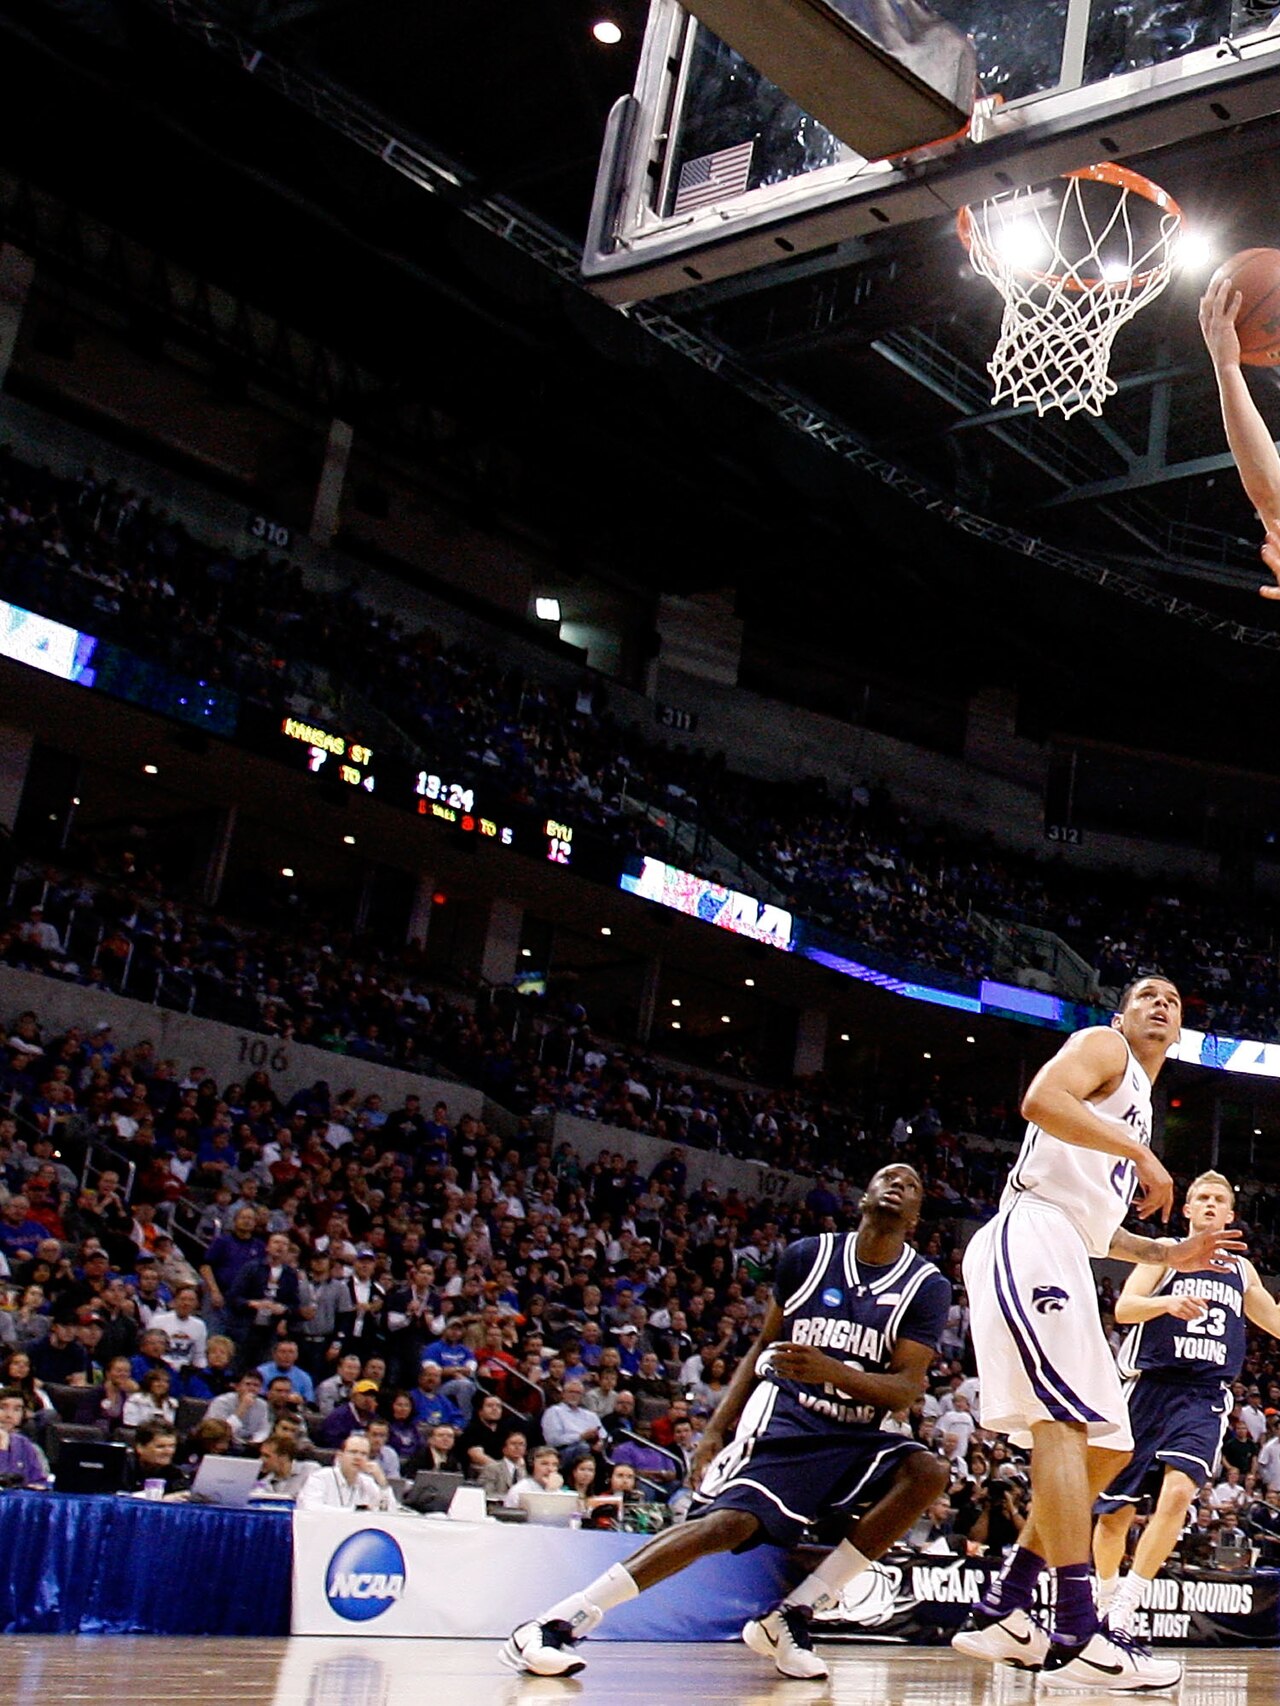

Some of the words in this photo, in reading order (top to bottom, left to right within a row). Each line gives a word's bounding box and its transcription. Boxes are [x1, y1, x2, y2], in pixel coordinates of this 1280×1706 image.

[250, 515, 289, 547] 310
[661, 707, 691, 730] 311
[284, 717, 345, 755] KANSAS
[350, 744, 373, 765] ST
[310, 747, 327, 772] 7
[340, 765, 361, 785] TO
[479, 816, 497, 837] TO
[545, 819, 573, 842] BYU
[1048, 824, 1079, 844] 312
[238, 1035, 289, 1072] 106
[758, 1171, 790, 1198] 107
[1186, 1305, 1227, 1337] 23
[791, 1317, 886, 1364] BRIGHA
[1173, 1335, 1228, 1366] YOUNG
[328, 1572, 405, 1600] NCAA
[1181, 1580, 1254, 1616] ROUNDS
[1152, 1612, 1192, 1639] HOST
